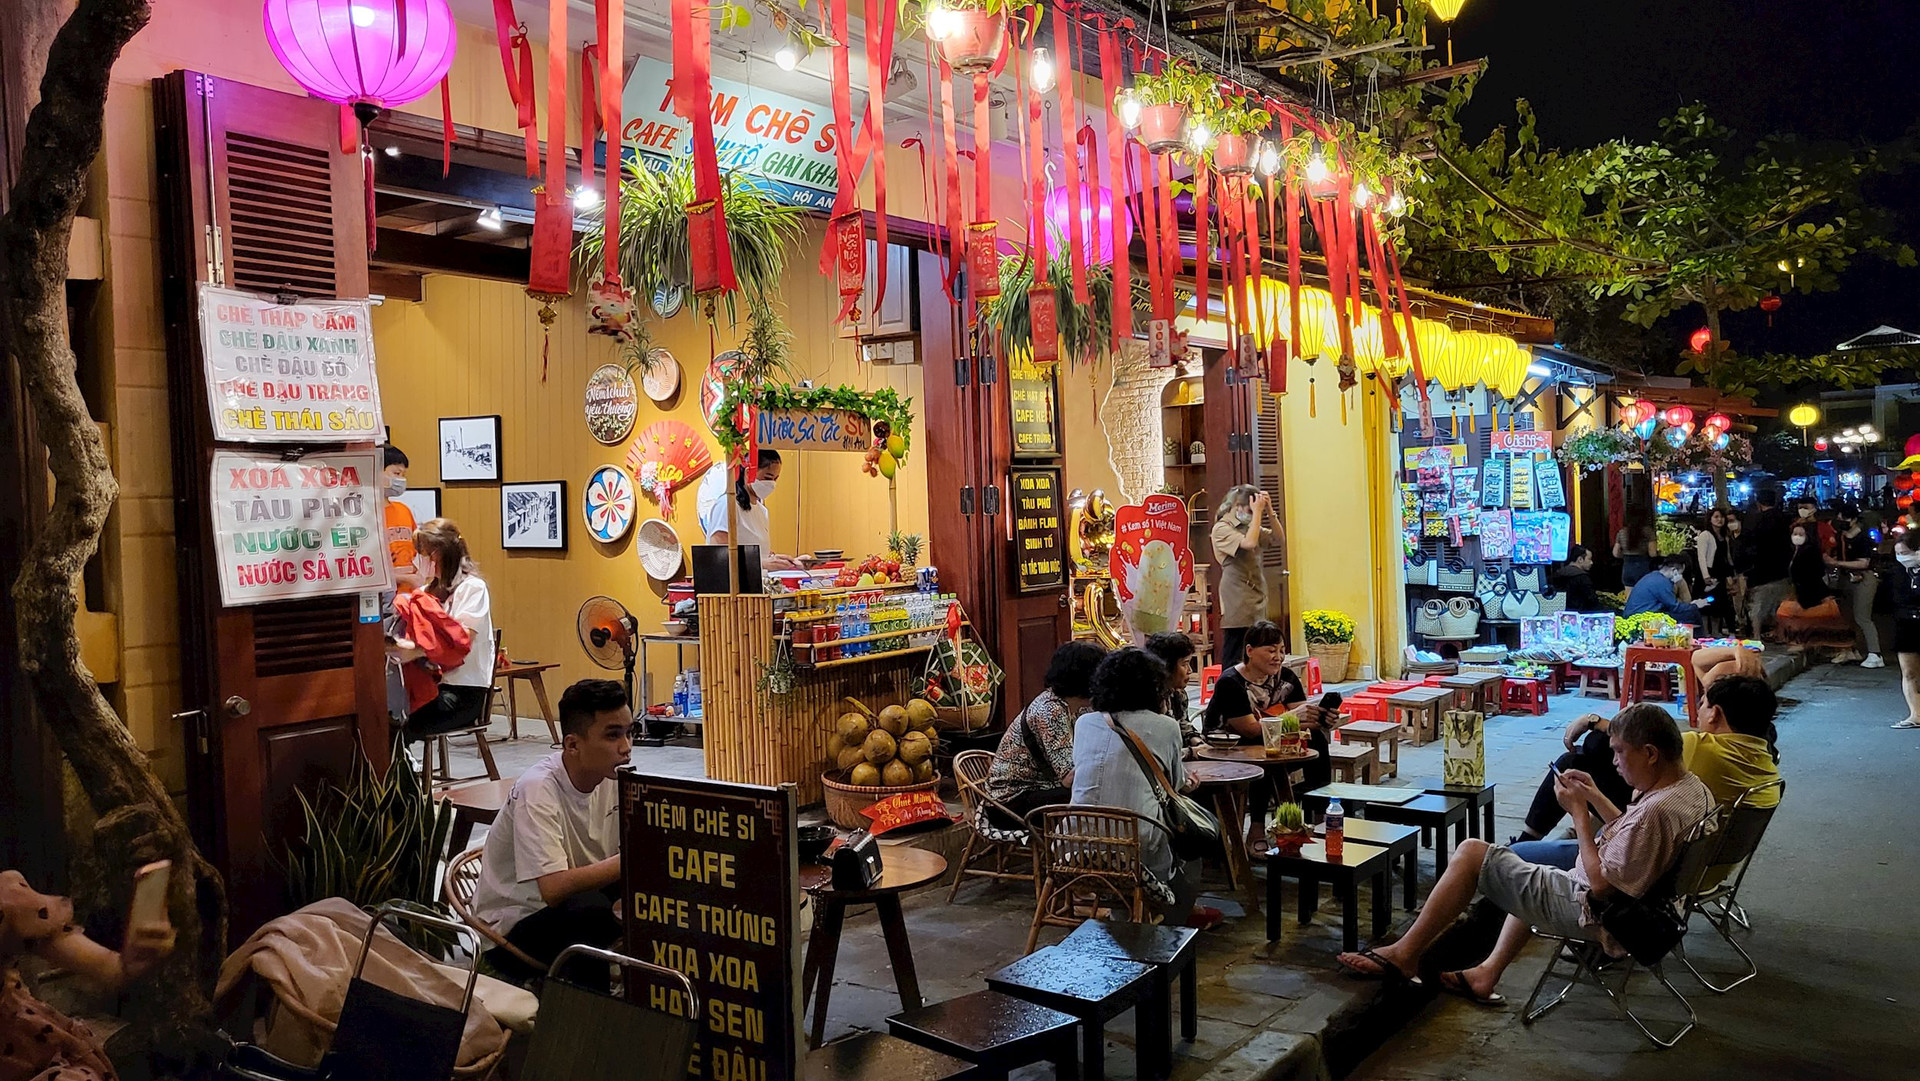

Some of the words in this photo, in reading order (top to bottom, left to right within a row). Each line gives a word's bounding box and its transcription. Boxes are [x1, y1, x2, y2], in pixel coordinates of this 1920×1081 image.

[659, 79, 739, 127] TM
[622, 118, 682, 150] CAFE
[792, 190, 813, 204] HỘI
[815, 196, 835, 209] AN
[217, 304, 253, 325] CHÈ
[258, 308, 306, 331] THẬP
[219, 329, 257, 349] CHÈ
[263, 332, 301, 354] ĐẬU
[307, 336, 357, 354] XANH
[236, 355, 272, 375] CHÈ
[279, 356, 317, 379] ĐẬU
[263, 380, 301, 402] ĐẬU
[223, 406, 267, 431] CHÈ
[272, 407, 322, 431] THÁI
[1016, 409, 1034, 423] CAFE
[1018, 433, 1032, 444] CAFE
[1504, 434, 1538, 448] Oishi
[300, 466, 360, 488] XOA
[1020, 479, 1034, 489] XOA
[1036, 478, 1050, 489] XOA
[230, 495, 291, 521] TÀU
[302, 492, 362, 518] PHỚ
[1022, 496, 1035, 509] TÀU
[1148, 501, 1177, 513] Merino
[233, 525, 321, 553] NƯỚC
[330, 523, 367, 547] ÉP
[1127, 521, 1141, 532] Kem
[1168, 522, 1182, 533] Nam
[237, 558, 296, 586] NƯỚC
[302, 552, 330, 580] SẢ
[335, 550, 373, 578] TẮC
[643, 799, 686, 834] TIỆM
[693, 806, 730, 837] CHÈ
[737, 814, 755, 841] SI
[668, 845, 736, 889] CAFE
[634, 892, 689, 929] CAFE
[697, 903, 776, 946] TRỨNG
[652, 940, 700, 980] XOA
[708, 951, 759, 993] XOA
[709, 998, 764, 1044] SEN
